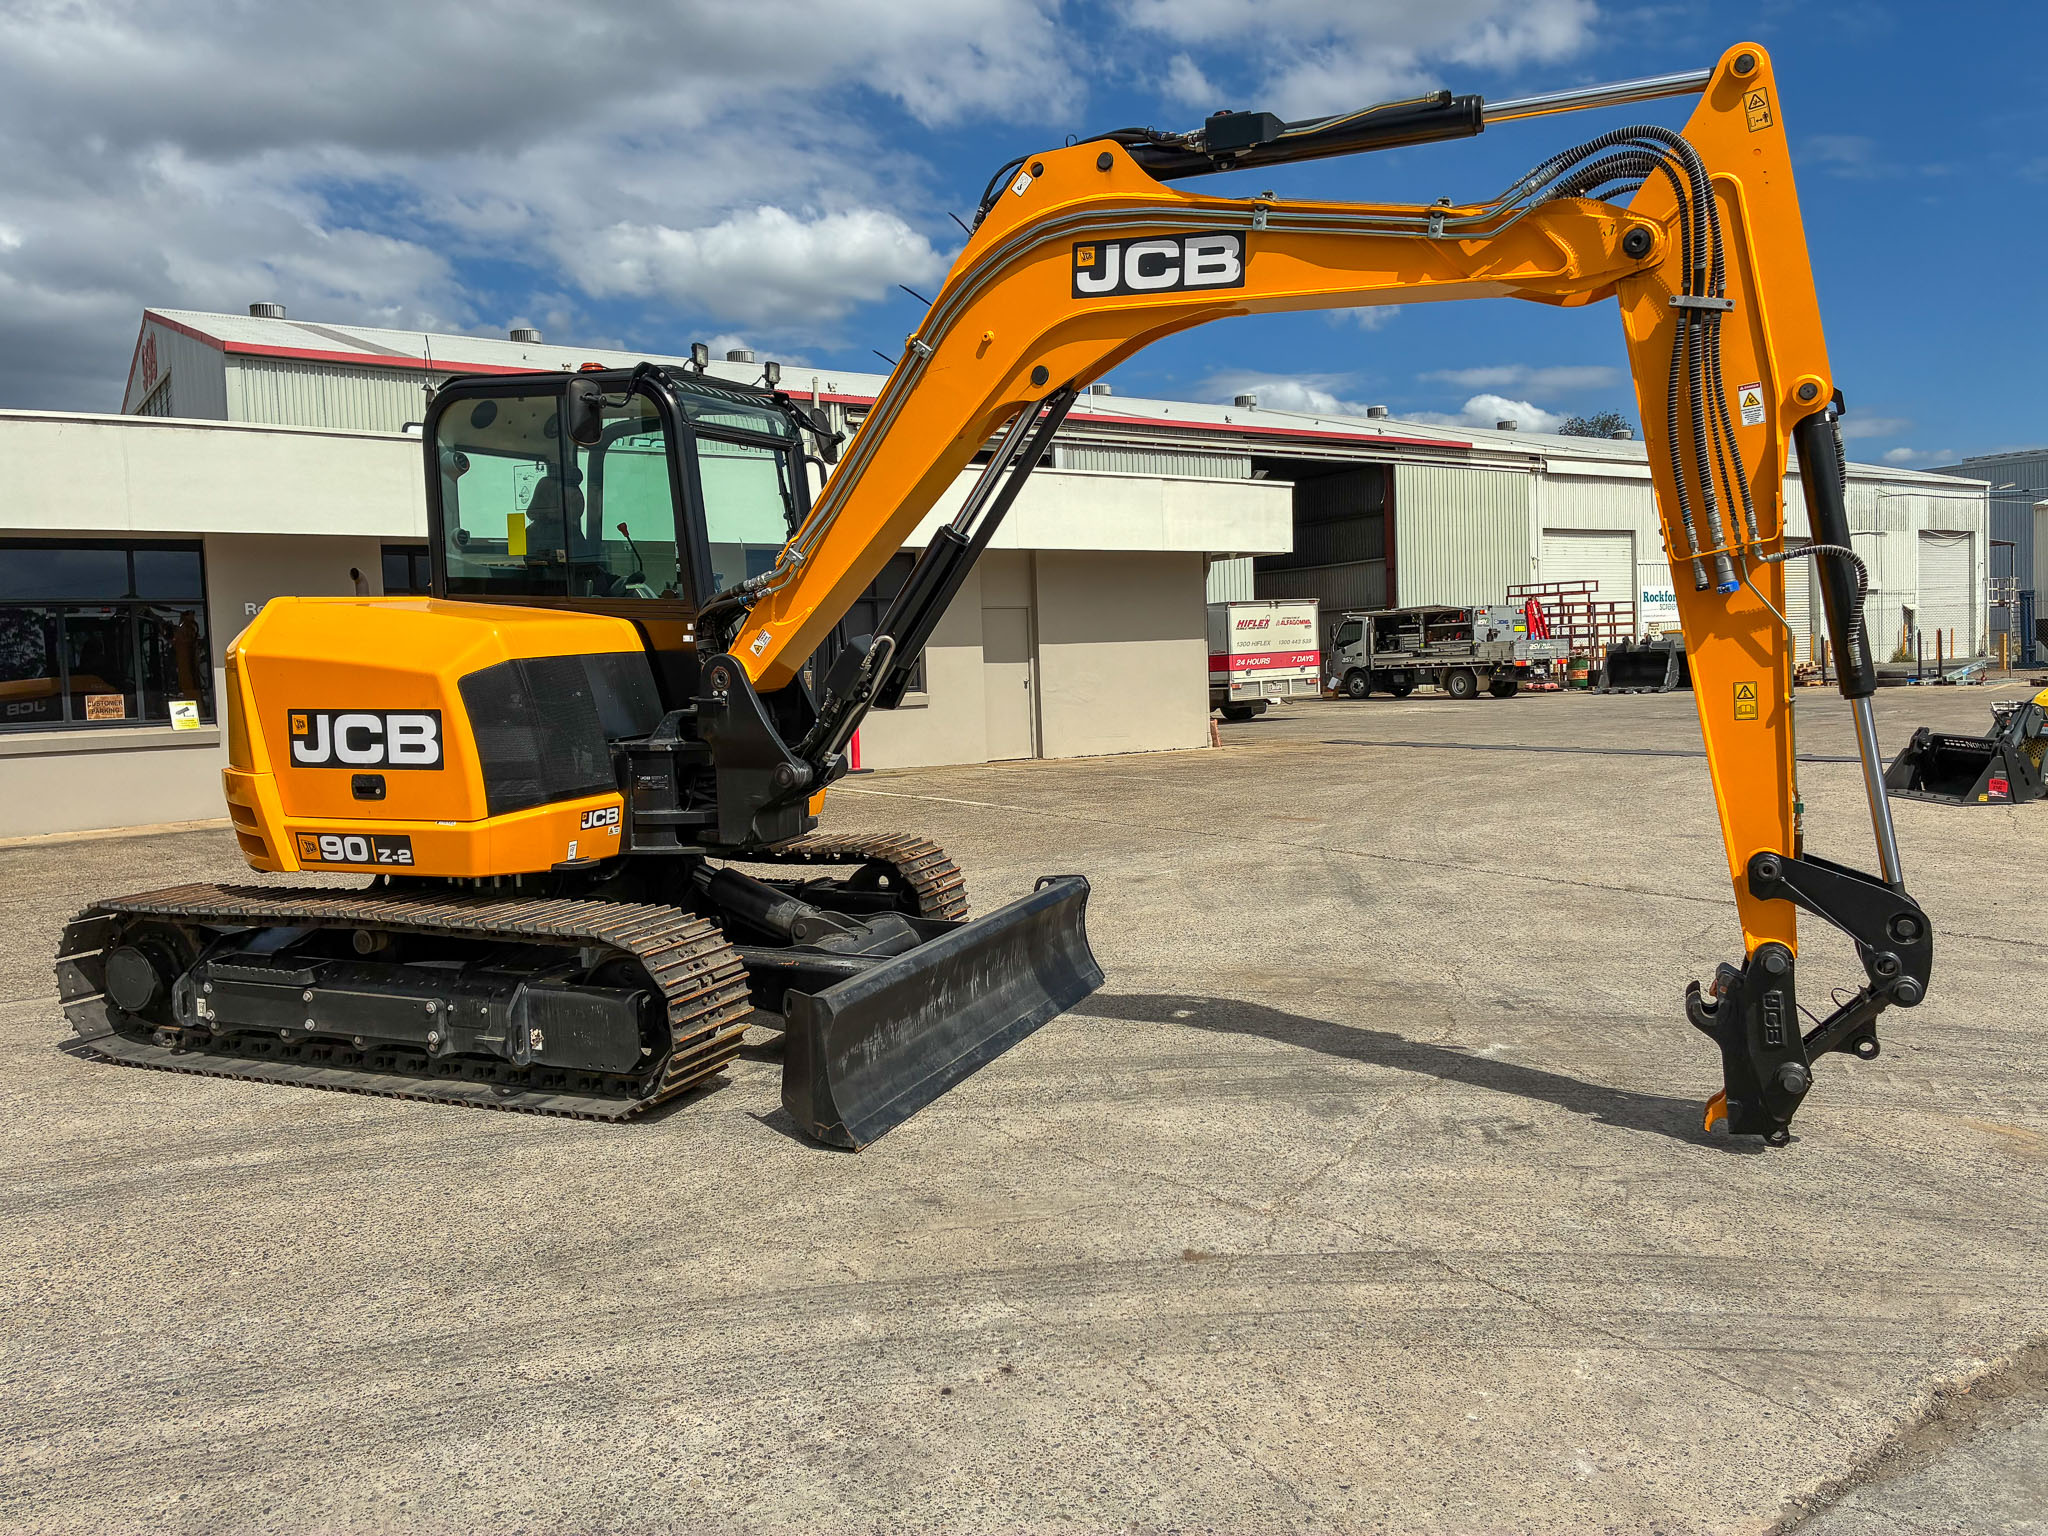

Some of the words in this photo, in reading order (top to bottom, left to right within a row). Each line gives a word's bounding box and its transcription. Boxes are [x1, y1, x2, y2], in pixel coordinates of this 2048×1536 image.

[1076, 235, 1241, 293] JCB
[1236, 618, 1270, 628] HIFLEX
[1246, 657, 1271, 665] HOURS
[293, 714, 439, 764] JCB
[581, 807, 619, 829] JCB
[319, 835, 369, 862] 90
[377, 848, 413, 863] Z-2
